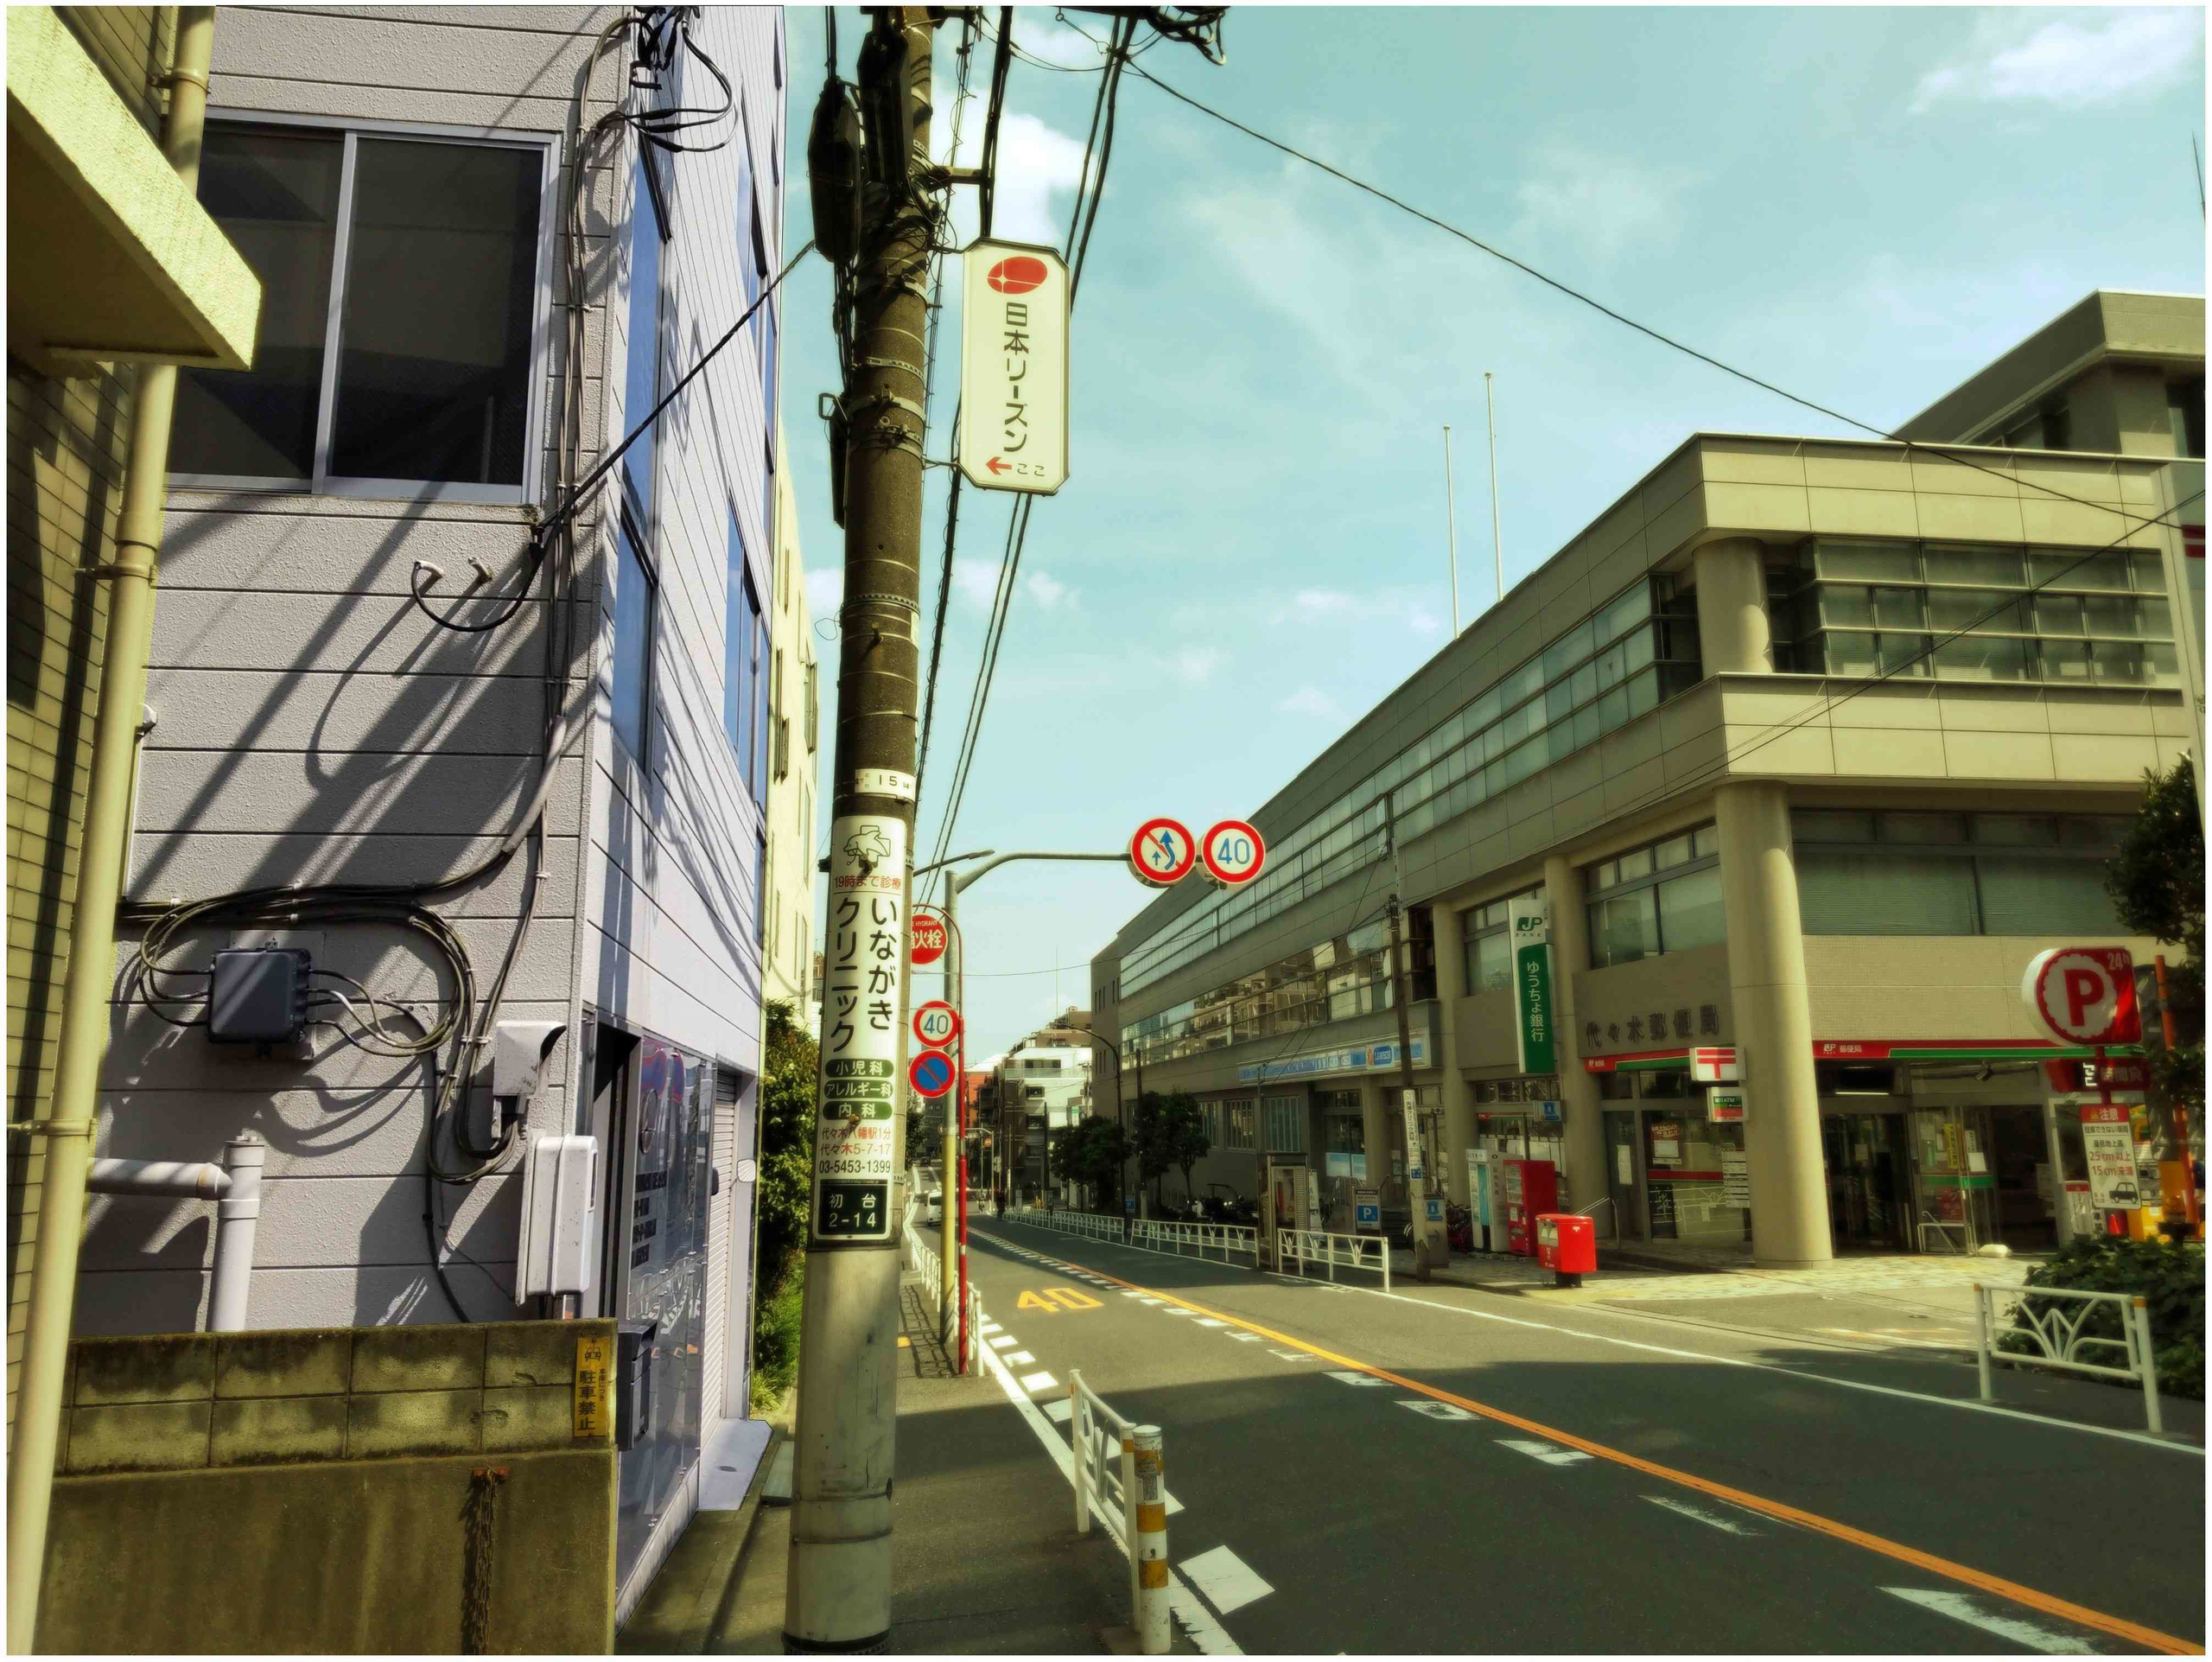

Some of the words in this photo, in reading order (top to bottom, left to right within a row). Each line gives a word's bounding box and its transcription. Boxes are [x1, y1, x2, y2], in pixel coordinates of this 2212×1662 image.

[1003, 302, 1030, 453] 日本リーズン
[1016, 463, 1046, 477] ここ
[1217, 837, 1251, 865] 40
[834, 875, 902, 889] 19時まで診療
[868, 897, 898, 1030] いながき
[830, 897, 861, 1054] クリニック
[1527, 960, 1545, 1042] ゆうちょ銀行
[2063, 968, 2105, 1027] P
[922, 1014, 950, 1035] 40
[836, 1060, 884, 1076] 小児科
[826, 1082, 893, 1098] アレルギー科
[838, 1102, 876, 1118] 内科
[820, 1142, 892, 1156] 代々木5-7-17
[819, 1159, 891, 1175] 03-5453-1399
[829, 1193, 877, 1209] 初台
[829, 1212, 877, 1228] 2-14
[1016, 1287, 1105, 1313] 40
[577, 1370, 597, 1431] 駐車禁止
